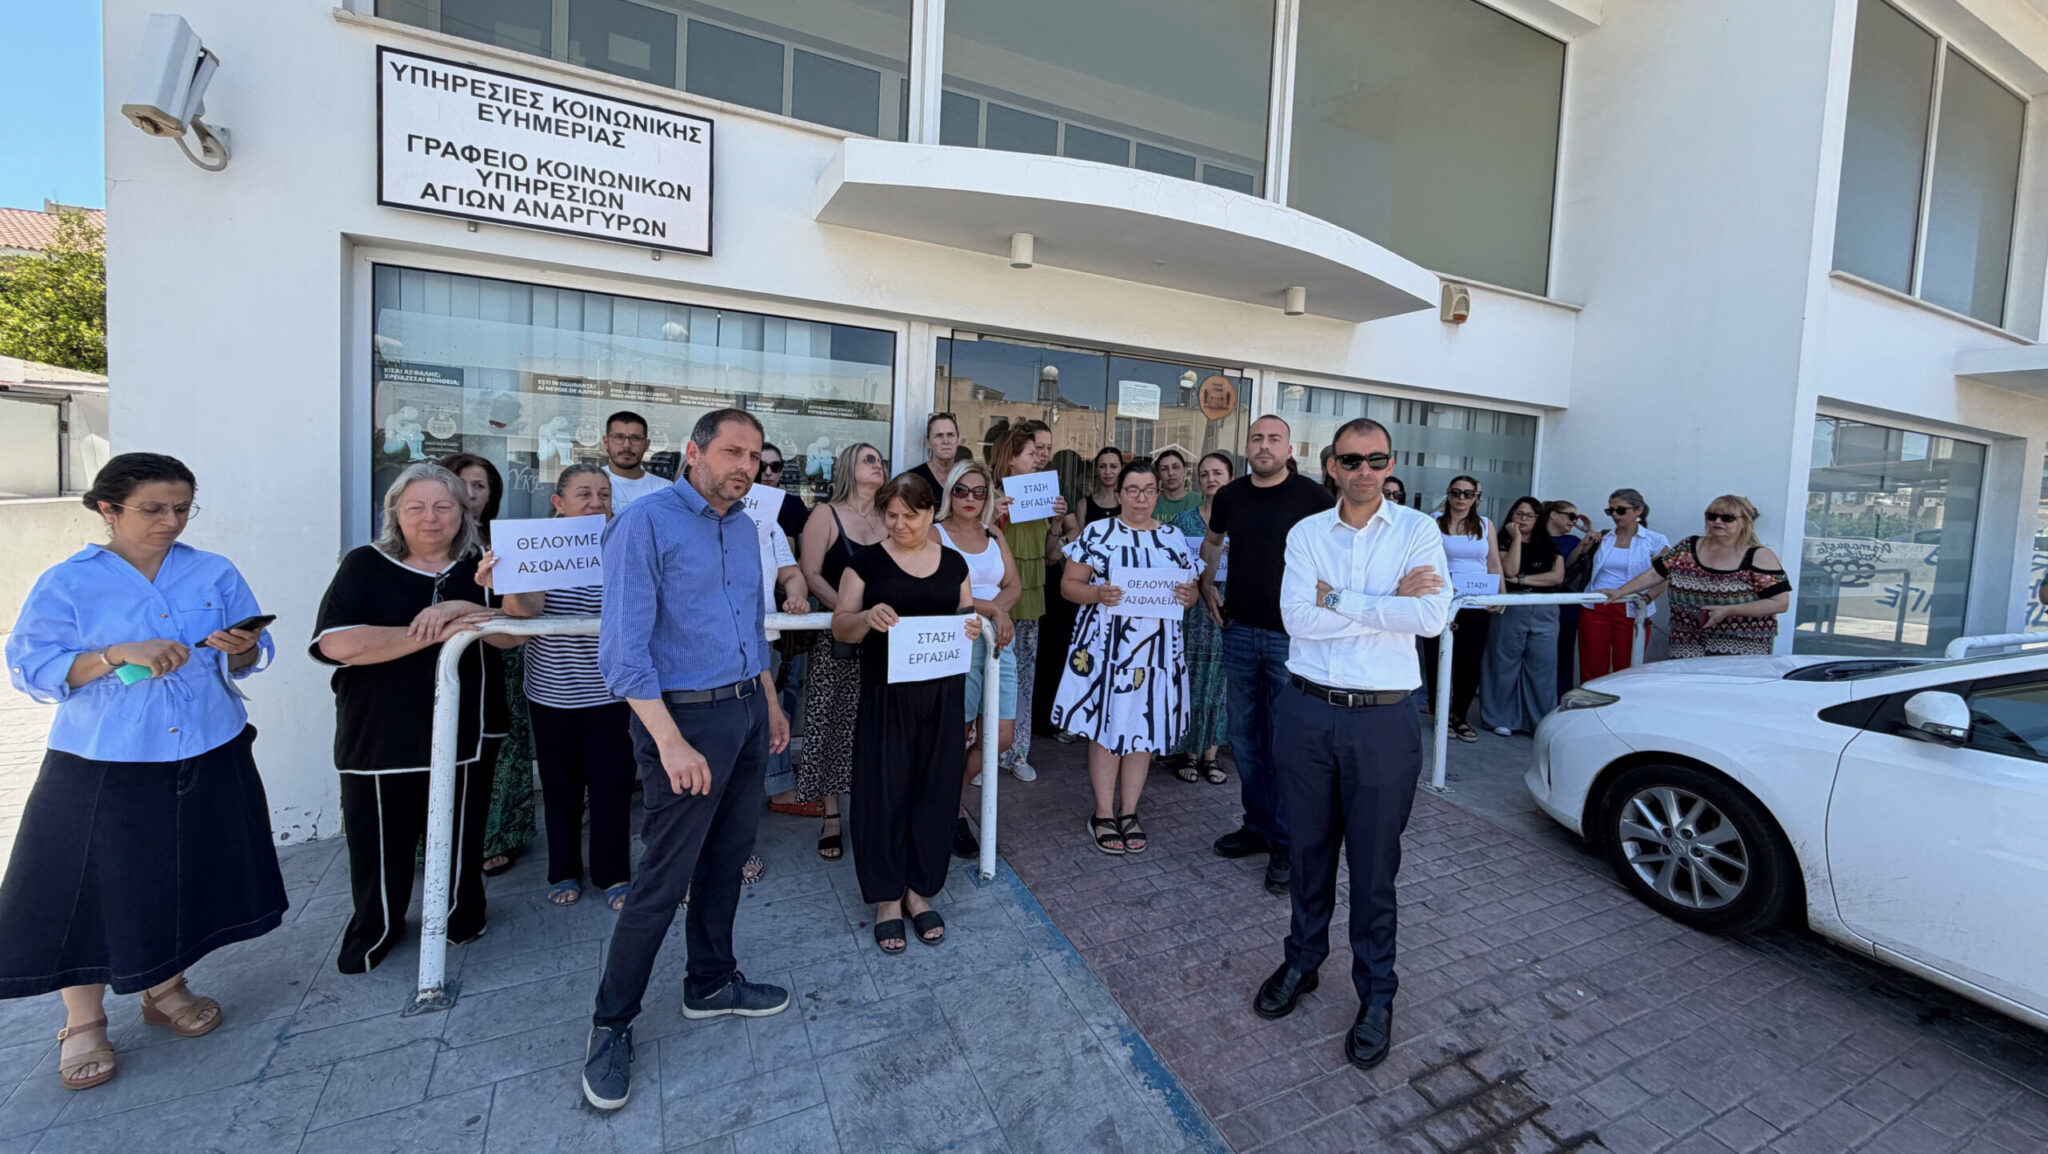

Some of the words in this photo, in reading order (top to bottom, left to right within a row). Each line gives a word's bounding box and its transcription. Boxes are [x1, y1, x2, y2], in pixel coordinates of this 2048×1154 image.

[390, 61, 544, 111] ΥΠΗΡΕΣΙΕΣ
[552, 96, 702, 144] ΚΟΙΝΩΝΙΚΗΣ
[477, 102, 626, 149] ΕΥΗΜΕΡΙΑΣ
[407, 133, 528, 172] ΓΡΑΦΕΙΟ
[536, 157, 691, 202] ΚΟΙΝΩΝΙΚΩΝ
[475, 168, 624, 210] ΥΠΗΡΕΣΙΩΝ
[420, 182, 505, 212] ΑΓΙΩΝ
[512, 197, 666, 238] ΑΝΑΡΓΥΡΩΝ
[1024, 484, 1048, 494] ΣΤΑΣΗ
[517, 533, 599, 550] ΘΕΛΟΥΜΕ
[518, 556, 601, 574] ΑΣΦΑΛΕΙΑ
[1467, 581, 1488, 589] ΣΤΑΣΗ
[1124, 596, 1178, 606] ΑΣΦΑΛΕΙΑ
[917, 631, 956, 644] ΣΤΑΣΗ
[908, 648, 961, 665] ΕΡΓΑΣΙΑΣ
